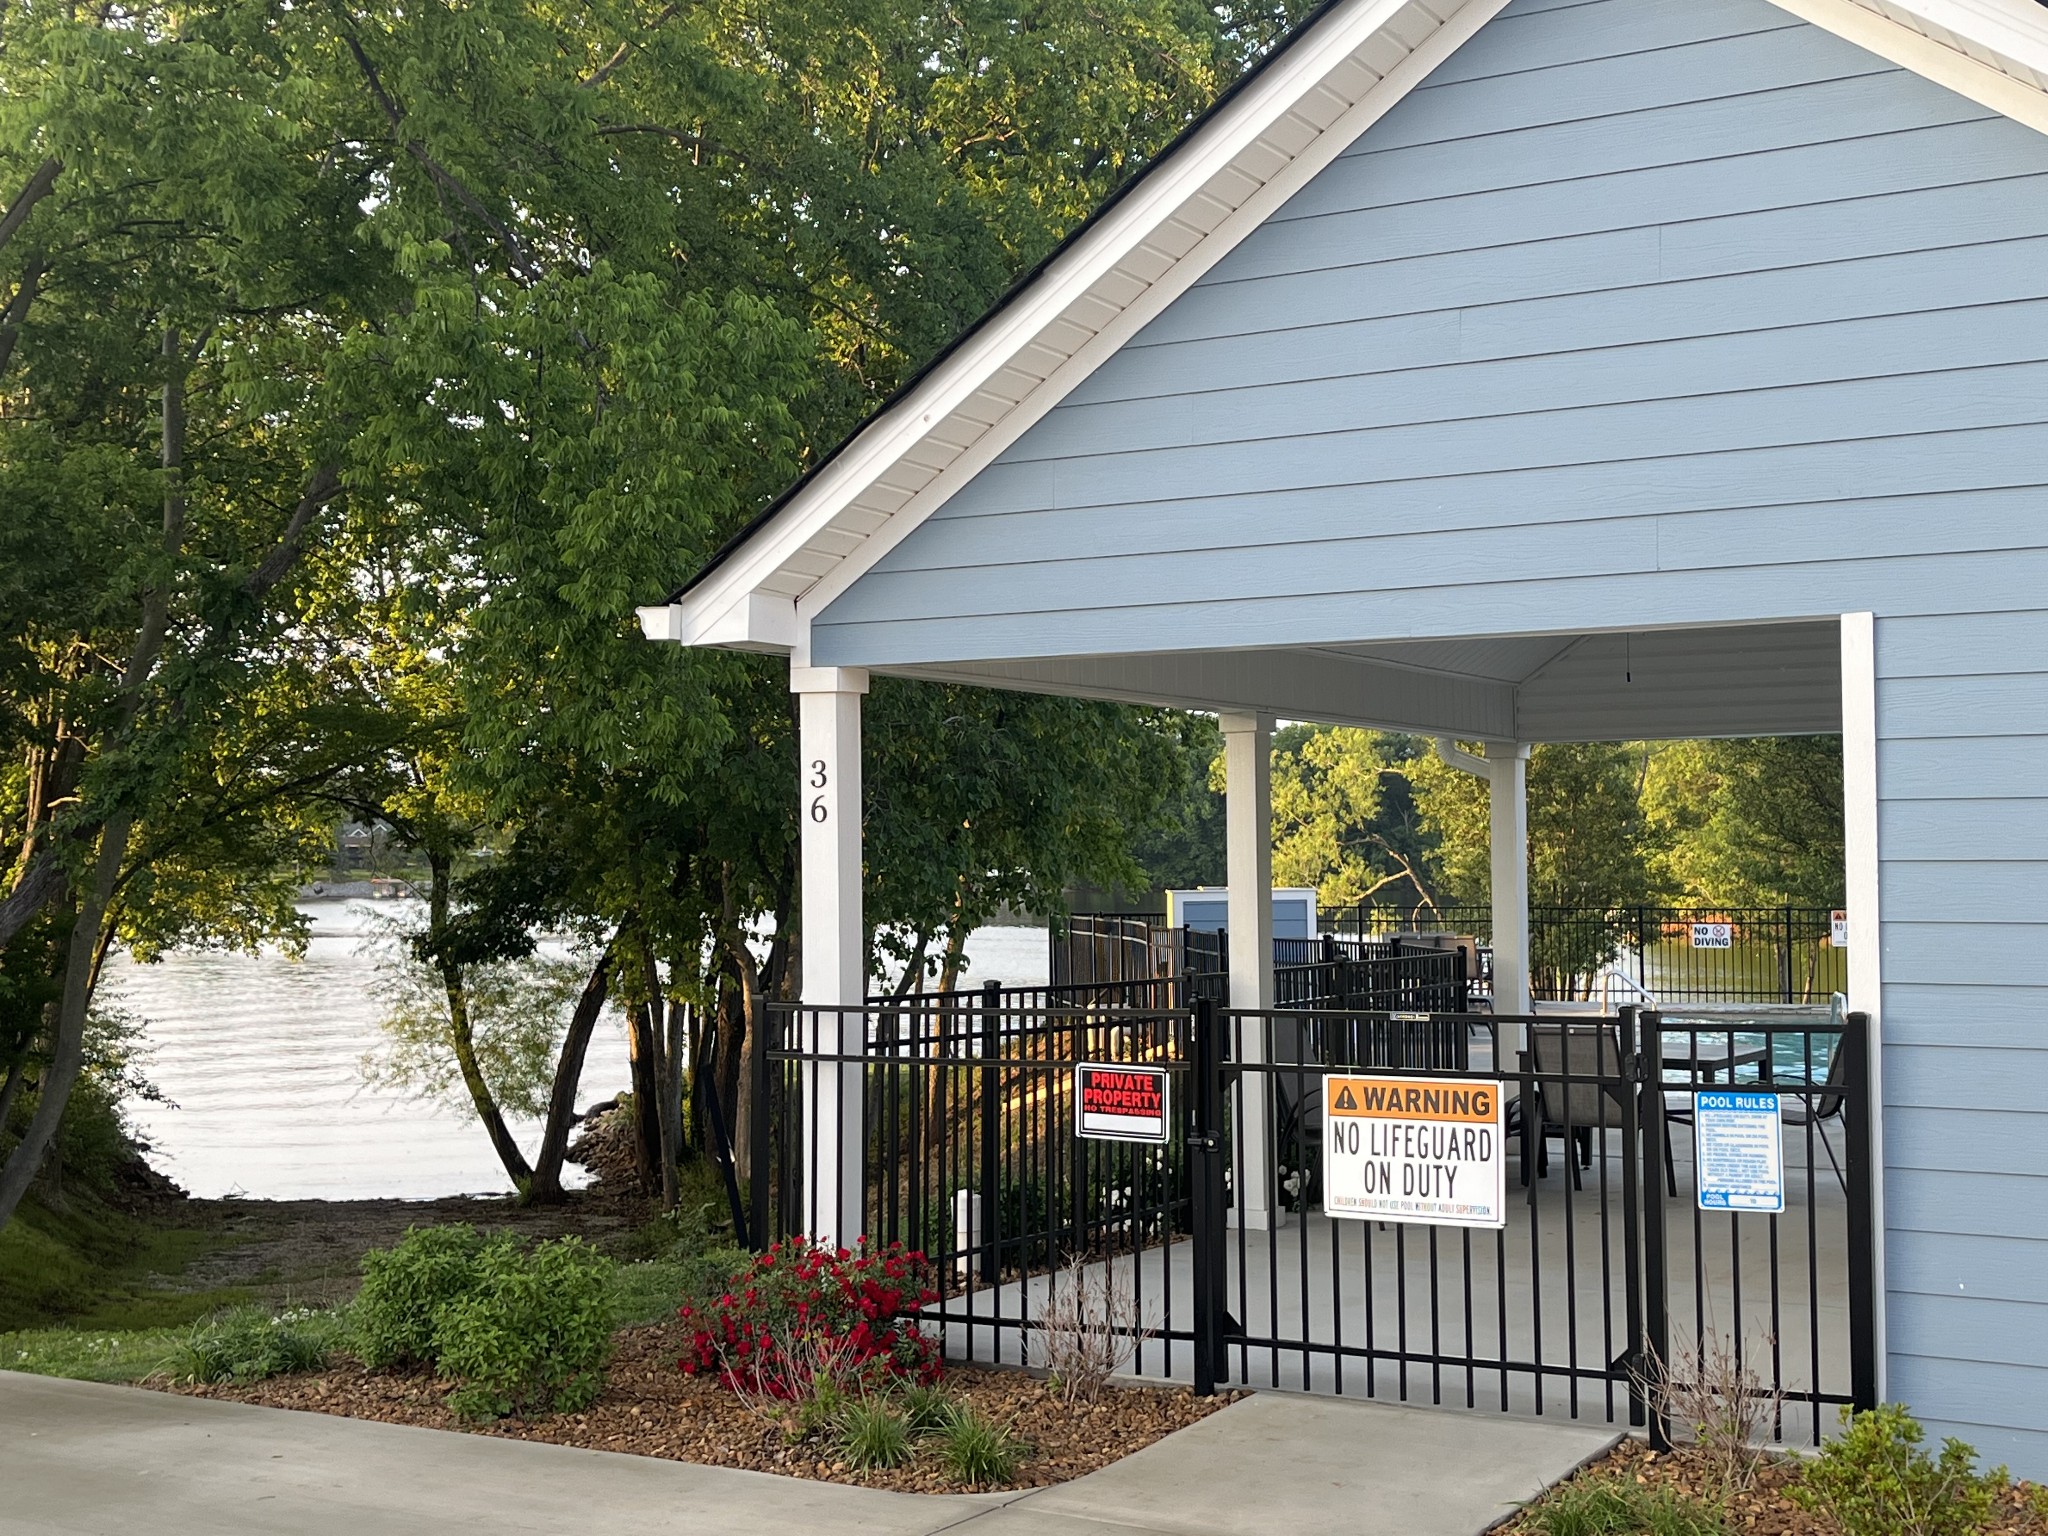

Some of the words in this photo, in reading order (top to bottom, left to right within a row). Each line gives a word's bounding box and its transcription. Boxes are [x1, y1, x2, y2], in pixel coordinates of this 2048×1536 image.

[1694, 926, 1708, 936] NO
[1694, 937, 1729, 946] DIVING
[1091, 1072, 1153, 1091] PRIVATE
[1084, 1088, 1161, 1108] PROPERTY
[1363, 1086, 1490, 1116] WARNING
[1701, 1096, 1733, 1108] POOL
[1735, 1097, 1775, 1109] RULES
[1084, 1104, 1097, 1112] NO
[1100, 1105, 1161, 1116] TRESPASSING
[1334, 1121, 1359, 1155] NO
[1371, 1123, 1491, 1162] LIFEGUARD
[1364, 1160, 1391, 1194] ON
[1403, 1163, 1458, 1199] DUTY
[1334, 1196, 1357, 1206] CHILDREN
[1359, 1198, 1377, 1208] SHOULD
[1379, 1199, 1388, 1209] NOT
[1401, 1201, 1413, 1211] POOL
